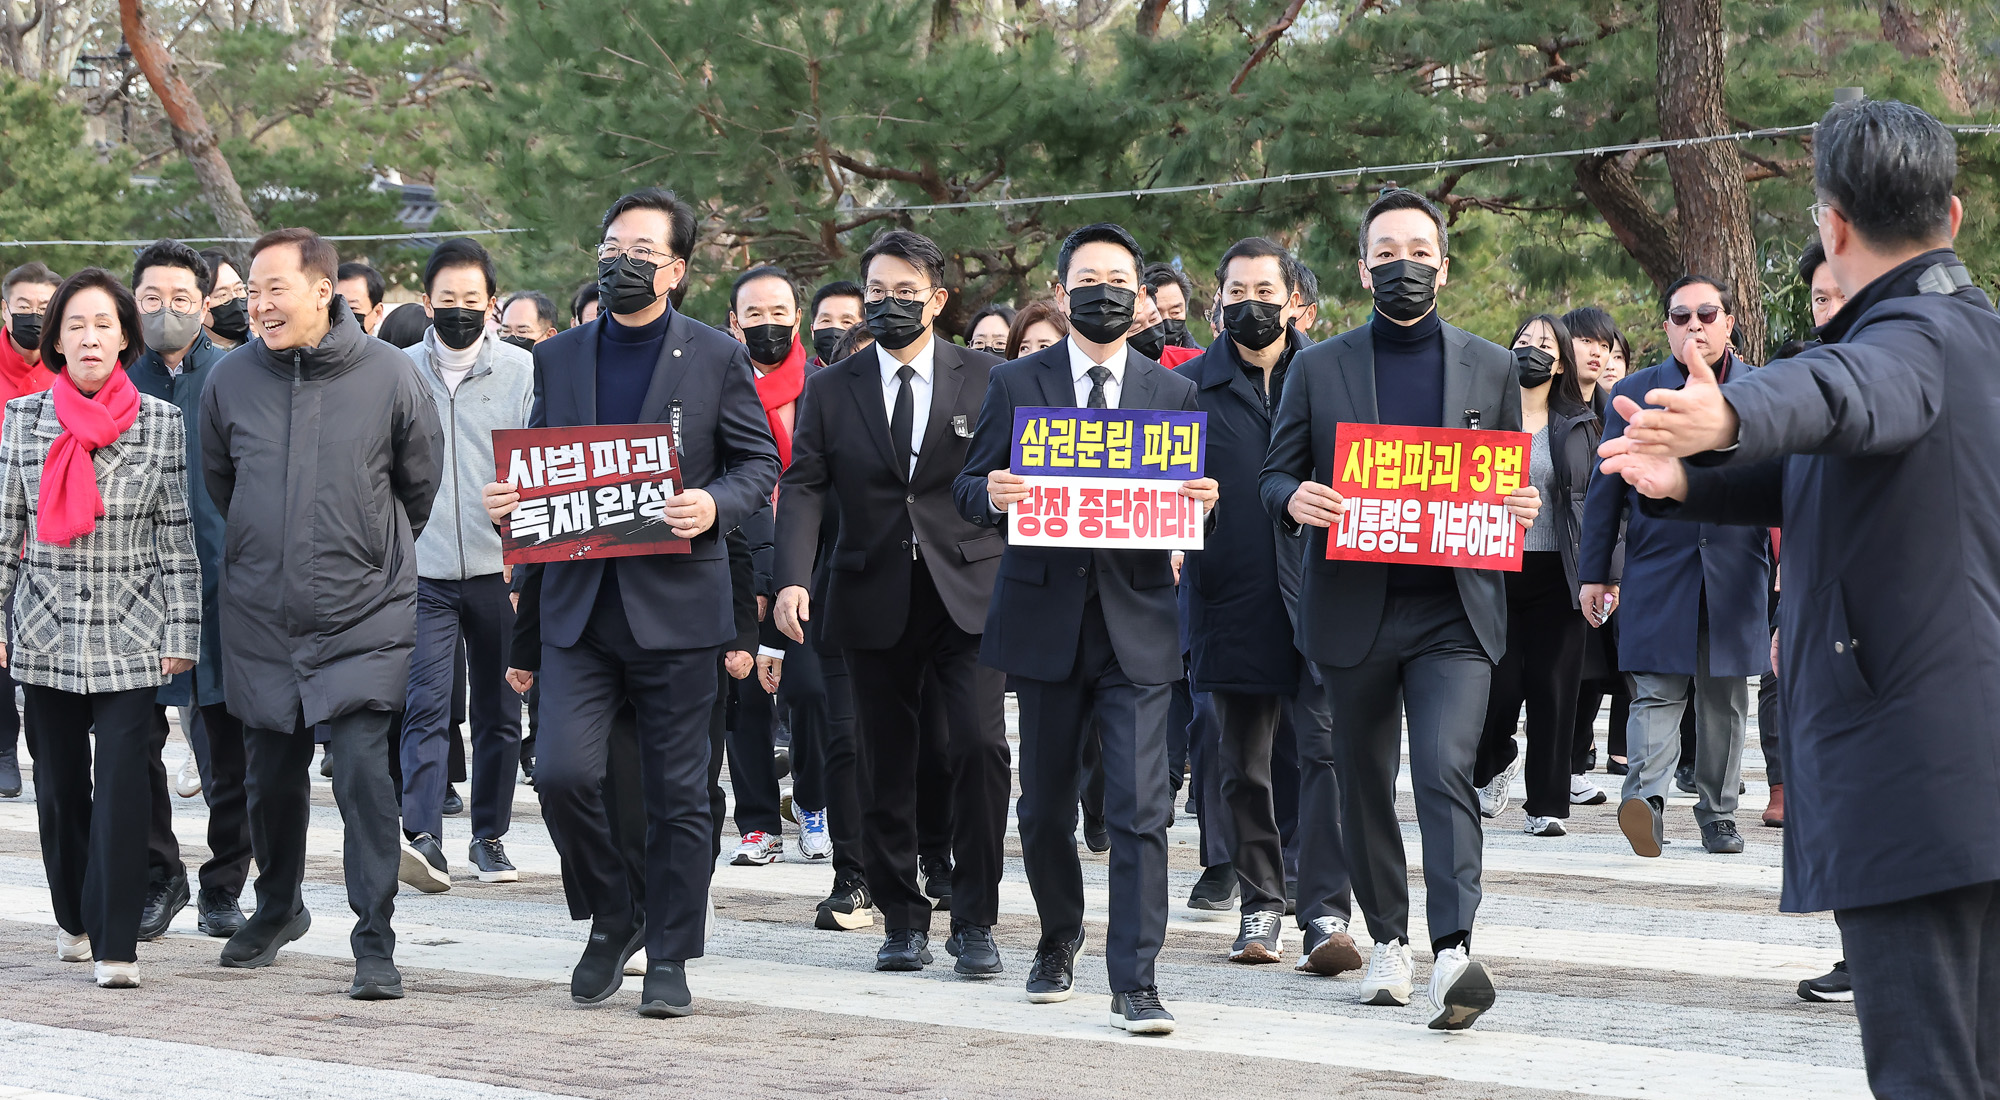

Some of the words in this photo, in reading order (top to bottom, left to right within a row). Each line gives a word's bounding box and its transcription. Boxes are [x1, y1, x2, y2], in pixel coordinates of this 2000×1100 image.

[506, 442, 587, 489] 사법
[589, 435, 674, 478] 파괴
[1019, 417, 1134, 469] 삼권분립
[1141, 421, 1200, 472] 파괴
[1341, 437, 1462, 492] 사법파괴
[1469, 445, 1523, 495] 3법
[509, 489, 593, 541] 독재
[594, 478, 675, 528] 완성
[1017, 485, 1070, 538] 당장
[1078, 487, 1195, 538] 중단하라!
[1336, 497, 1422, 553] 대통령은
[1427, 500, 1517, 558] 거부하라!
